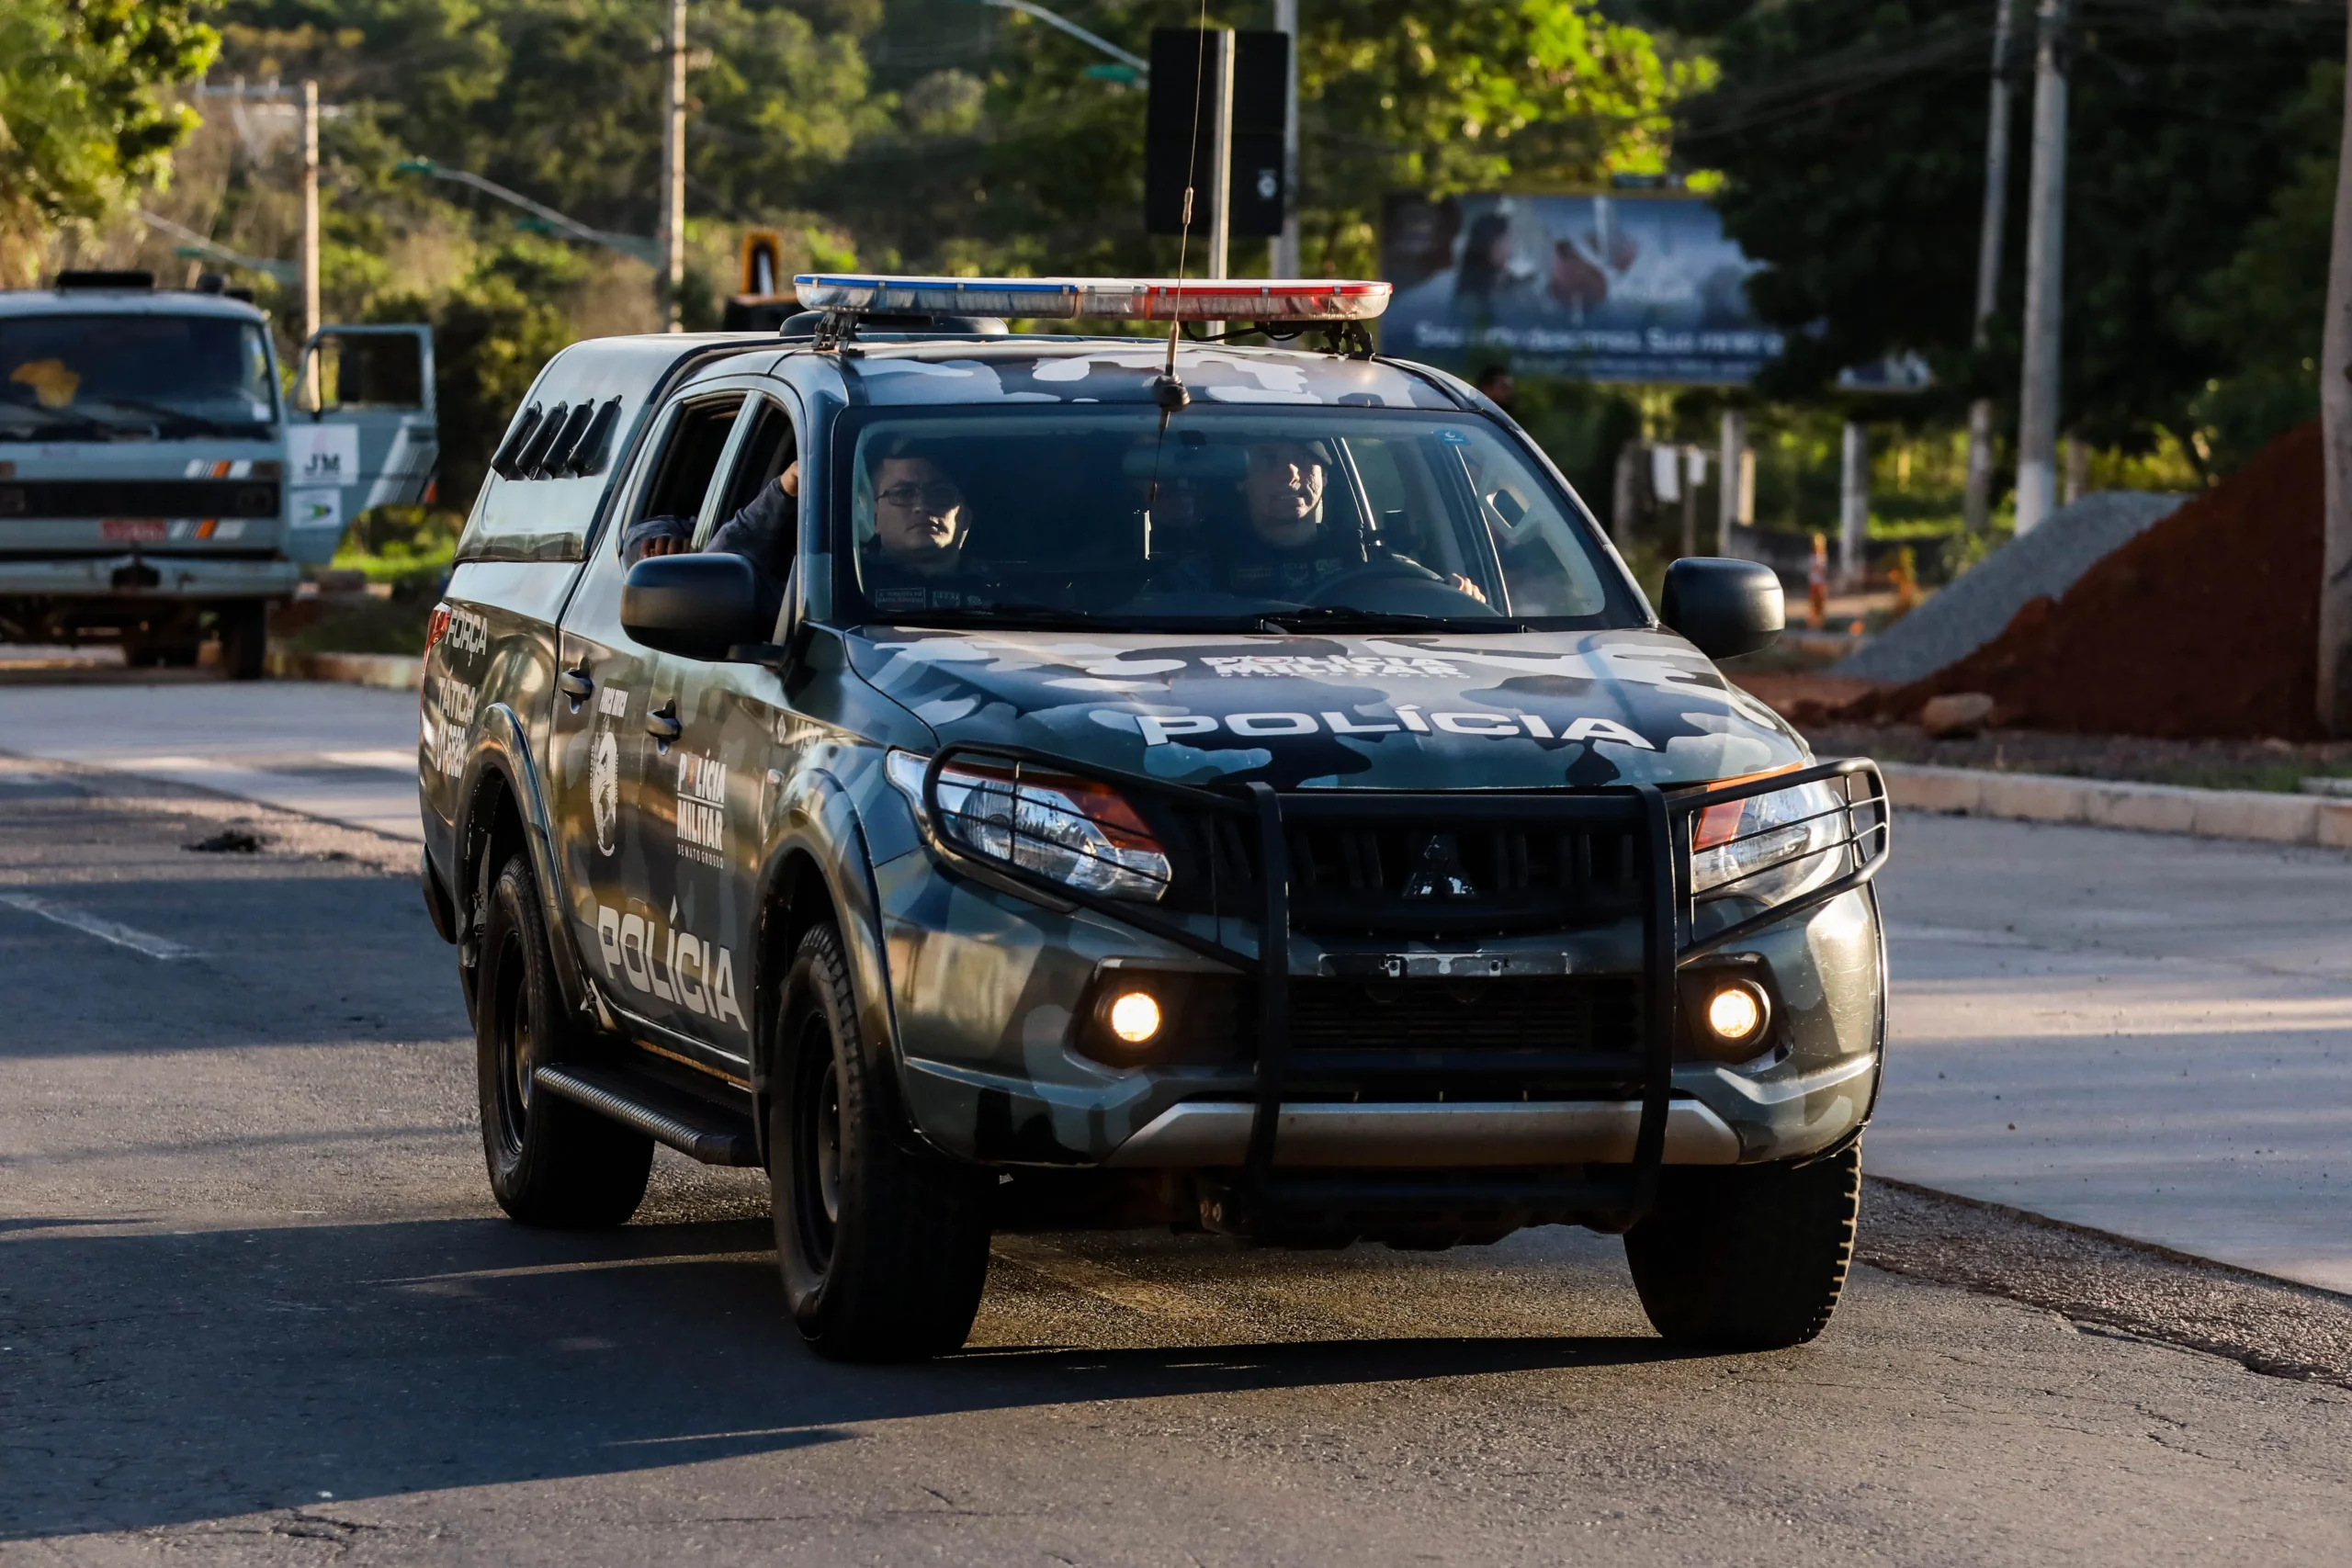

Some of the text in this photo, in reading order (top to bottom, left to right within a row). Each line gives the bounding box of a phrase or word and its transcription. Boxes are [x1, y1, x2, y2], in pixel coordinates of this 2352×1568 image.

[304, 453, 340, 475] JM
[445, 609, 488, 668] FORÇA
[438, 664, 477, 725] TÁTICA
[1215, 664, 1464, 675] MILITAR
[1135, 704, 1656, 750] POLÍCIA
[677, 748, 727, 804] POLÍCIA
[677, 799, 723, 852] MILITAR
[597, 894, 749, 1032] POLÍCIA
